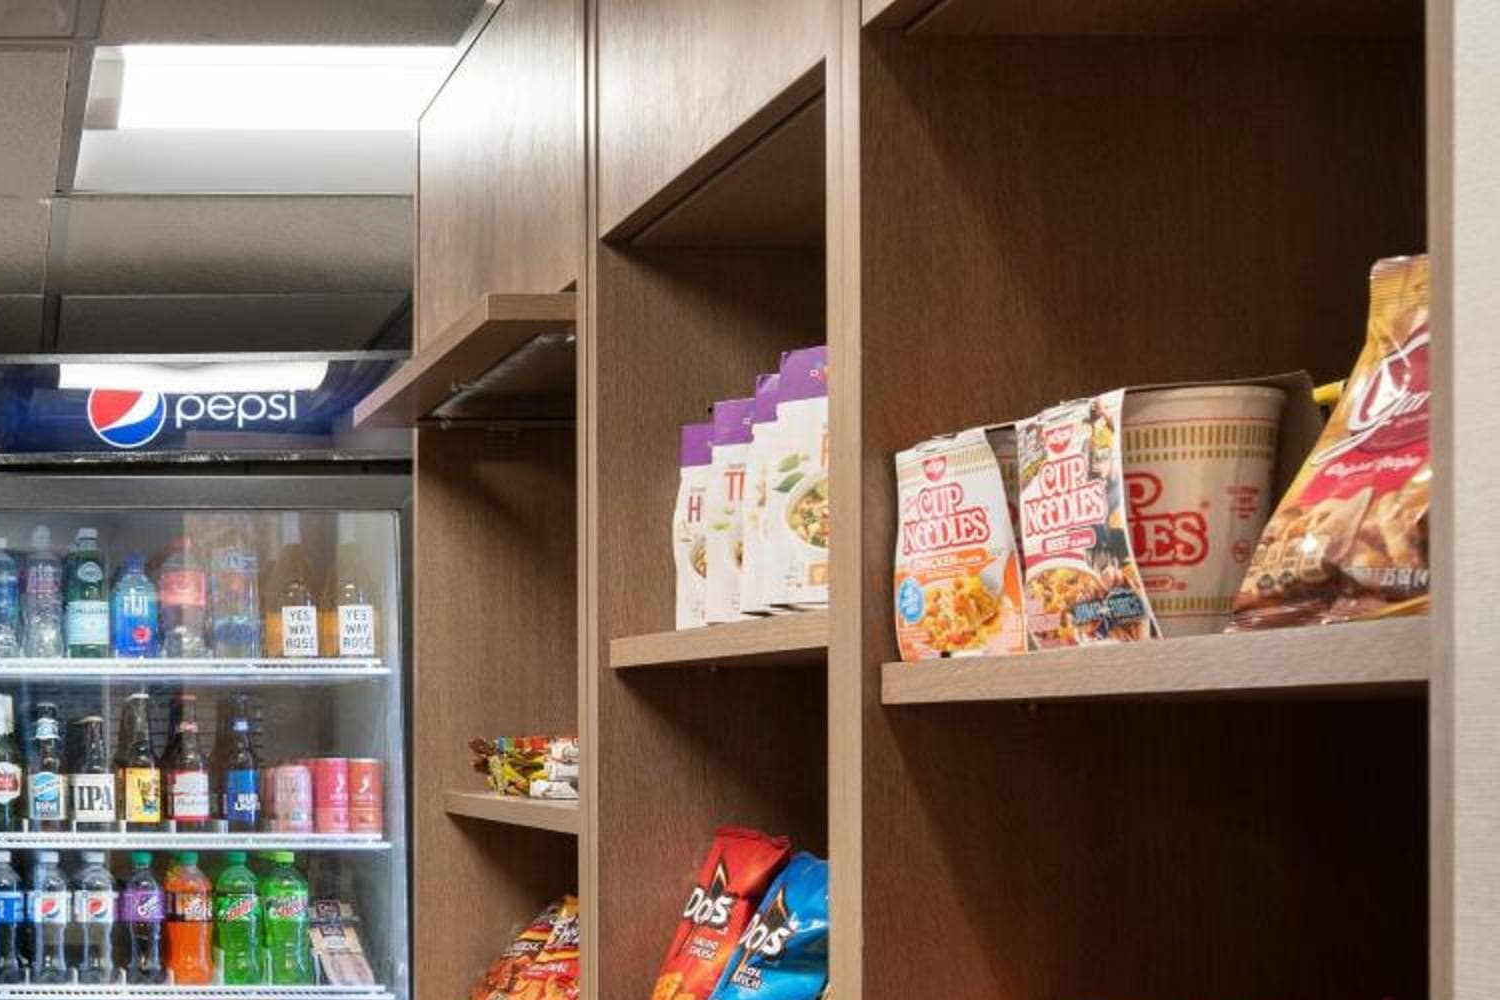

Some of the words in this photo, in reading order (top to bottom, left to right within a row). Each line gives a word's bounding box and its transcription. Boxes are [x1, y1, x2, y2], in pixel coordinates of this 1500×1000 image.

[175, 389, 297, 429] pepsi
[1039, 458, 1086, 495] CUP
[919, 484, 963, 518] CUP
[1024, 482, 1108, 537] NOODLES
[902, 508, 991, 555] NOODLES
[289, 609, 311, 622] YES
[345, 608, 368, 621] YES
